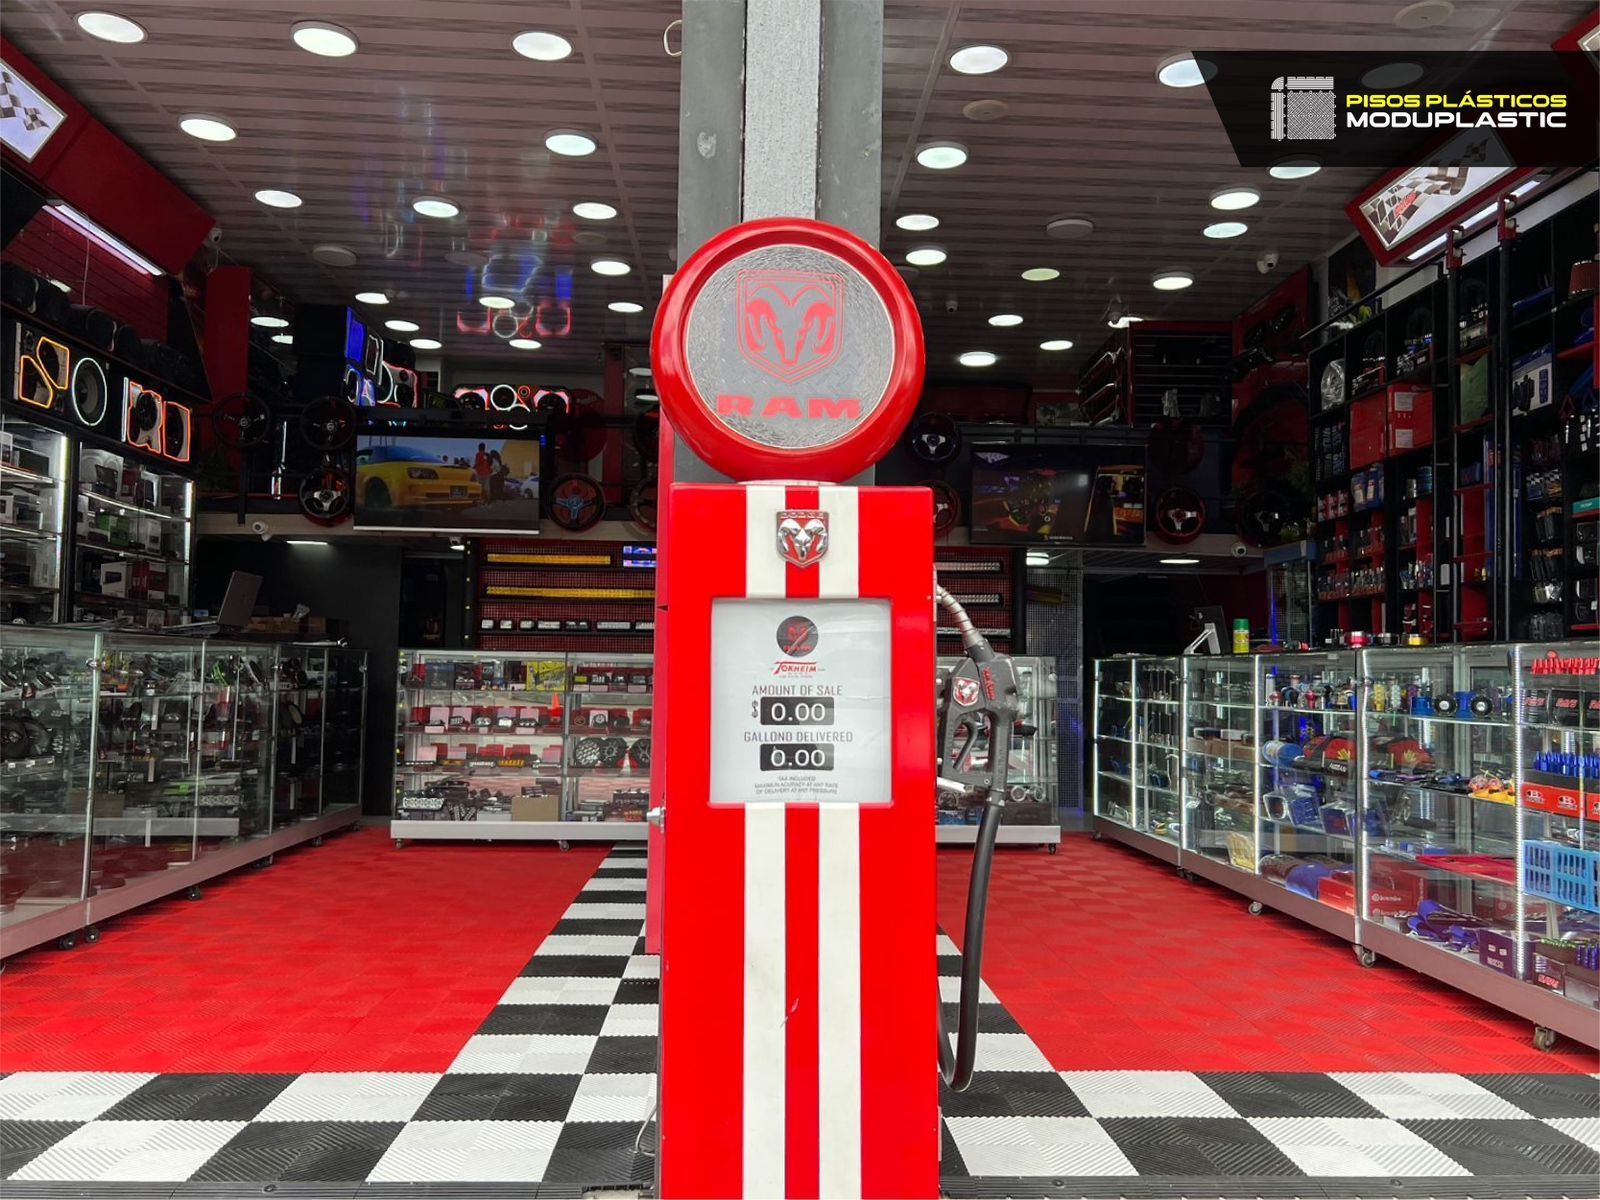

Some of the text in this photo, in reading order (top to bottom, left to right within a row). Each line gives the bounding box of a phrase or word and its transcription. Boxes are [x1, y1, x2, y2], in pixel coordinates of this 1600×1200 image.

[717, 395, 861, 419] RAM
[773, 661, 817, 675] TOKHEIM
[752, 685, 844, 696] AMOUNT OF SALE
[751, 700, 826, 721] $ 0.00
[744, 731, 854, 742] GALLOND DELIVERED
[771, 749, 826, 767] 0.00
